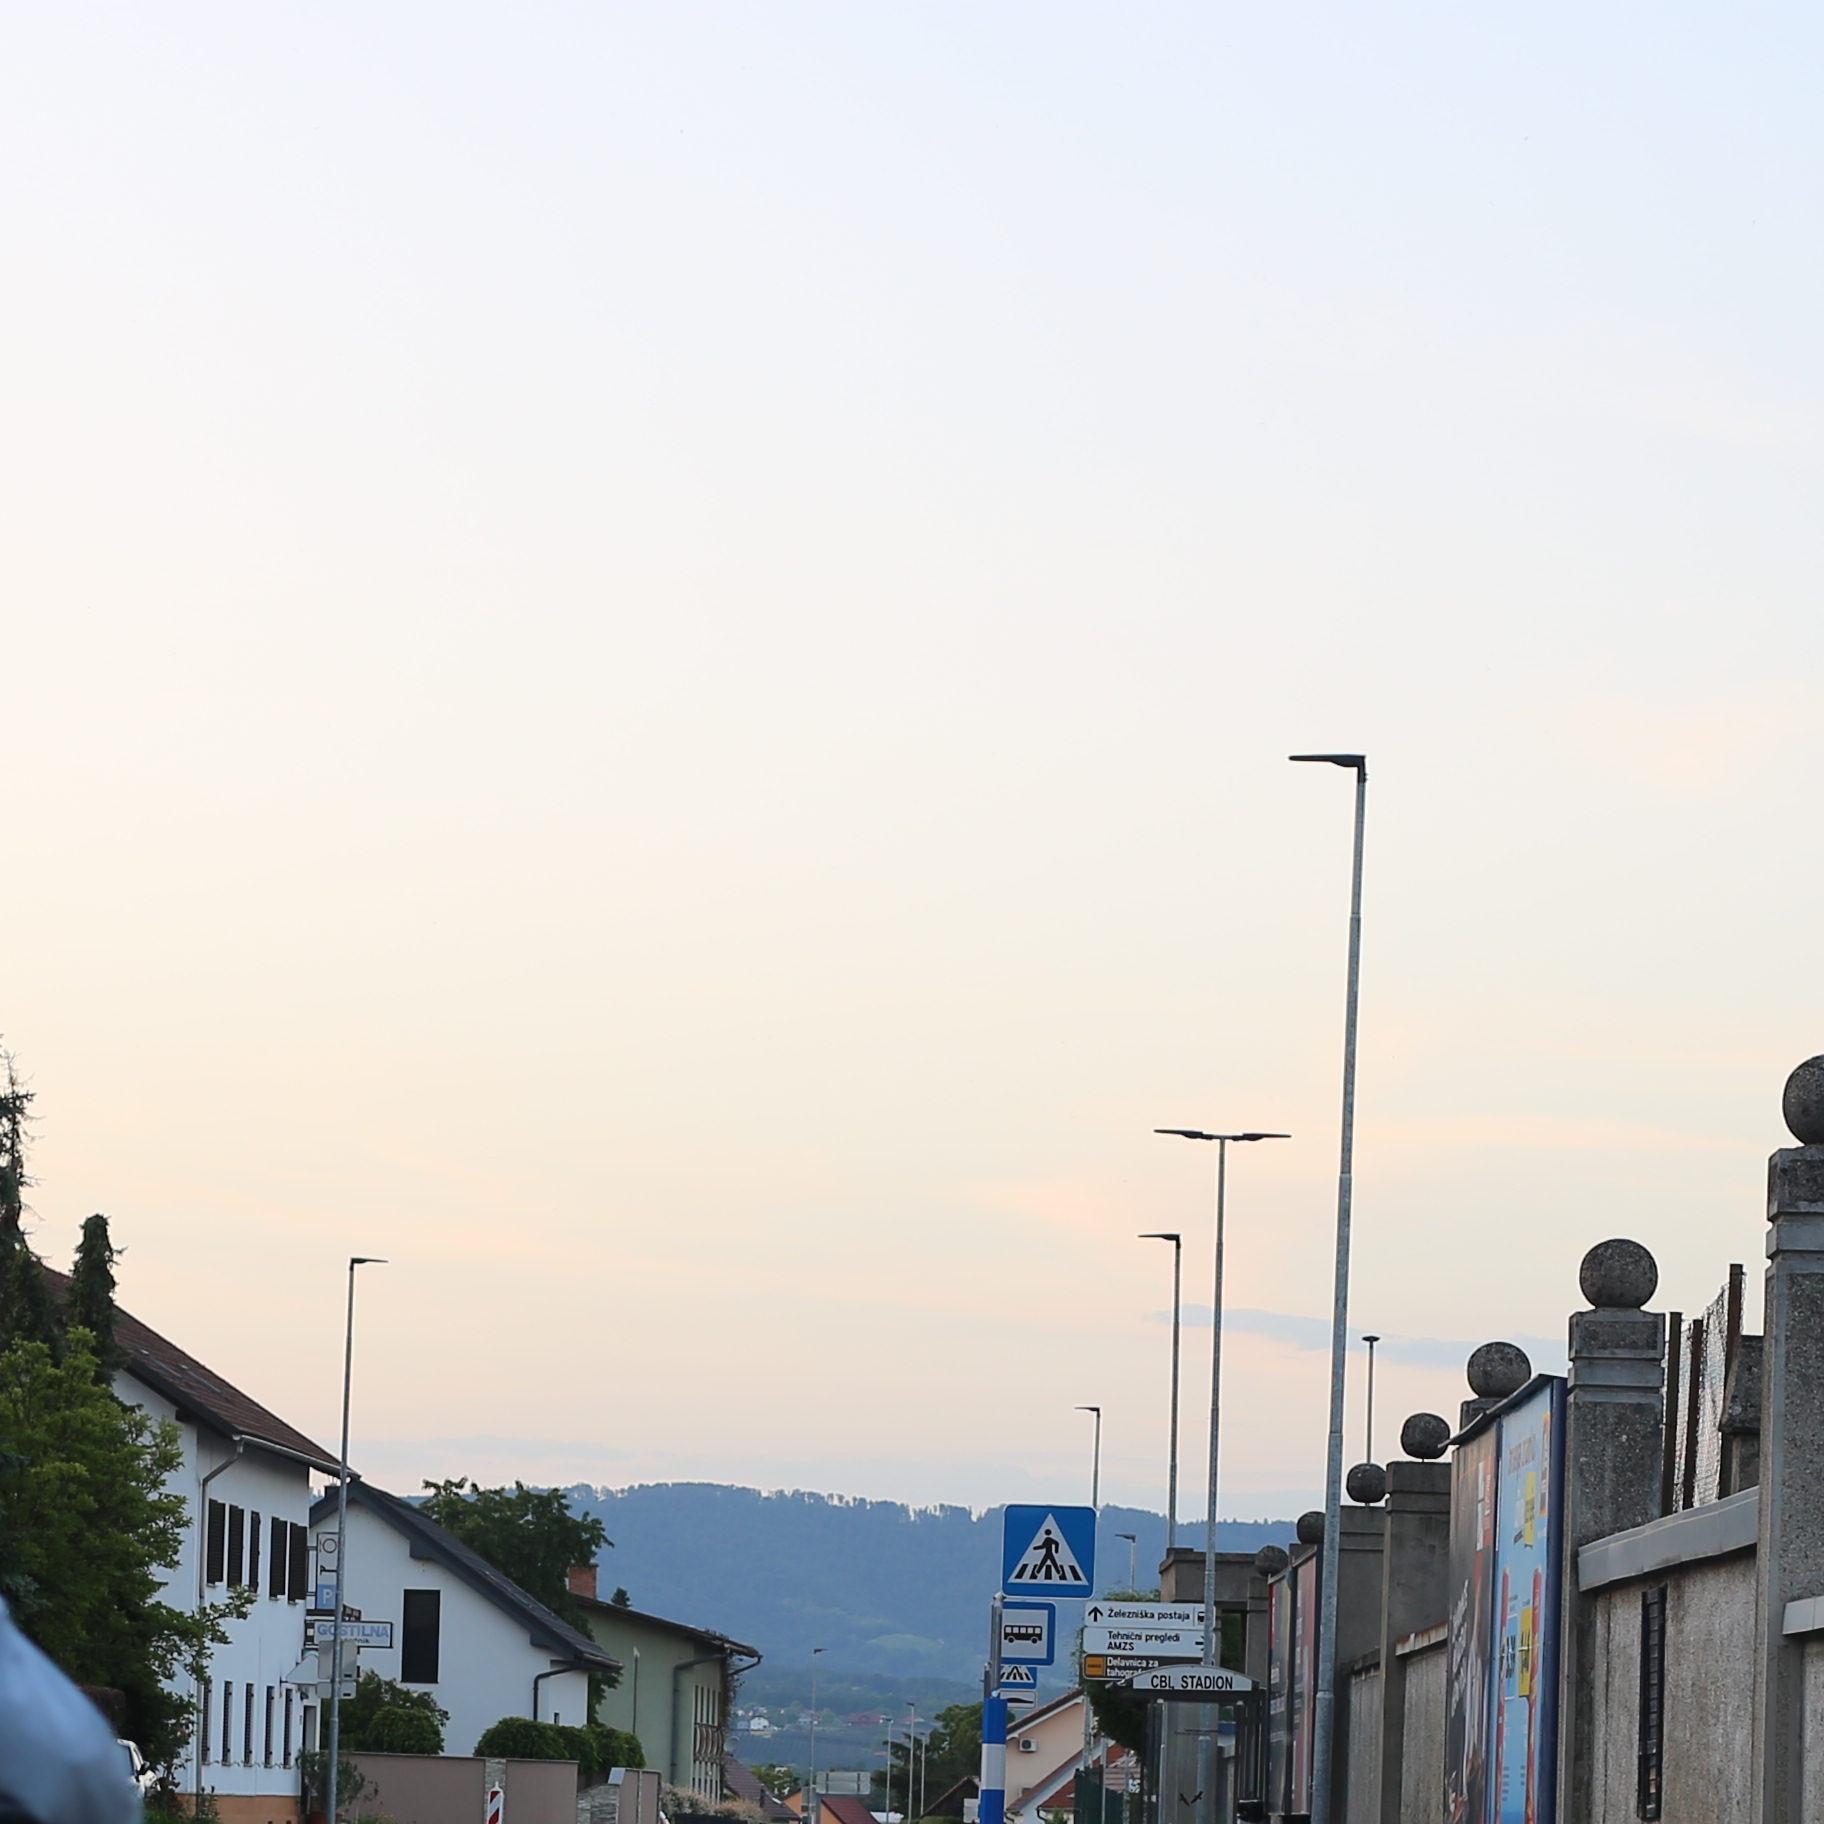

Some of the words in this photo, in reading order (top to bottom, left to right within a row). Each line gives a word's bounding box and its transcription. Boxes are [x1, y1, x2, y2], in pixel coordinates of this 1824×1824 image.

[322, 1588, 333, 1605] P
[1107, 1608, 1155, 1619] Železniška
[1157, 1611, 1190, 1621] postaja
[1145, 1632, 1181, 1643] pregledi
[1107, 1641, 1135, 1651] AMZS
[1107, 1656, 1147, 1667] Delavnica
[1148, 1659, 1159, 1667] za
[1180, 1675, 1233, 1690] STADION
